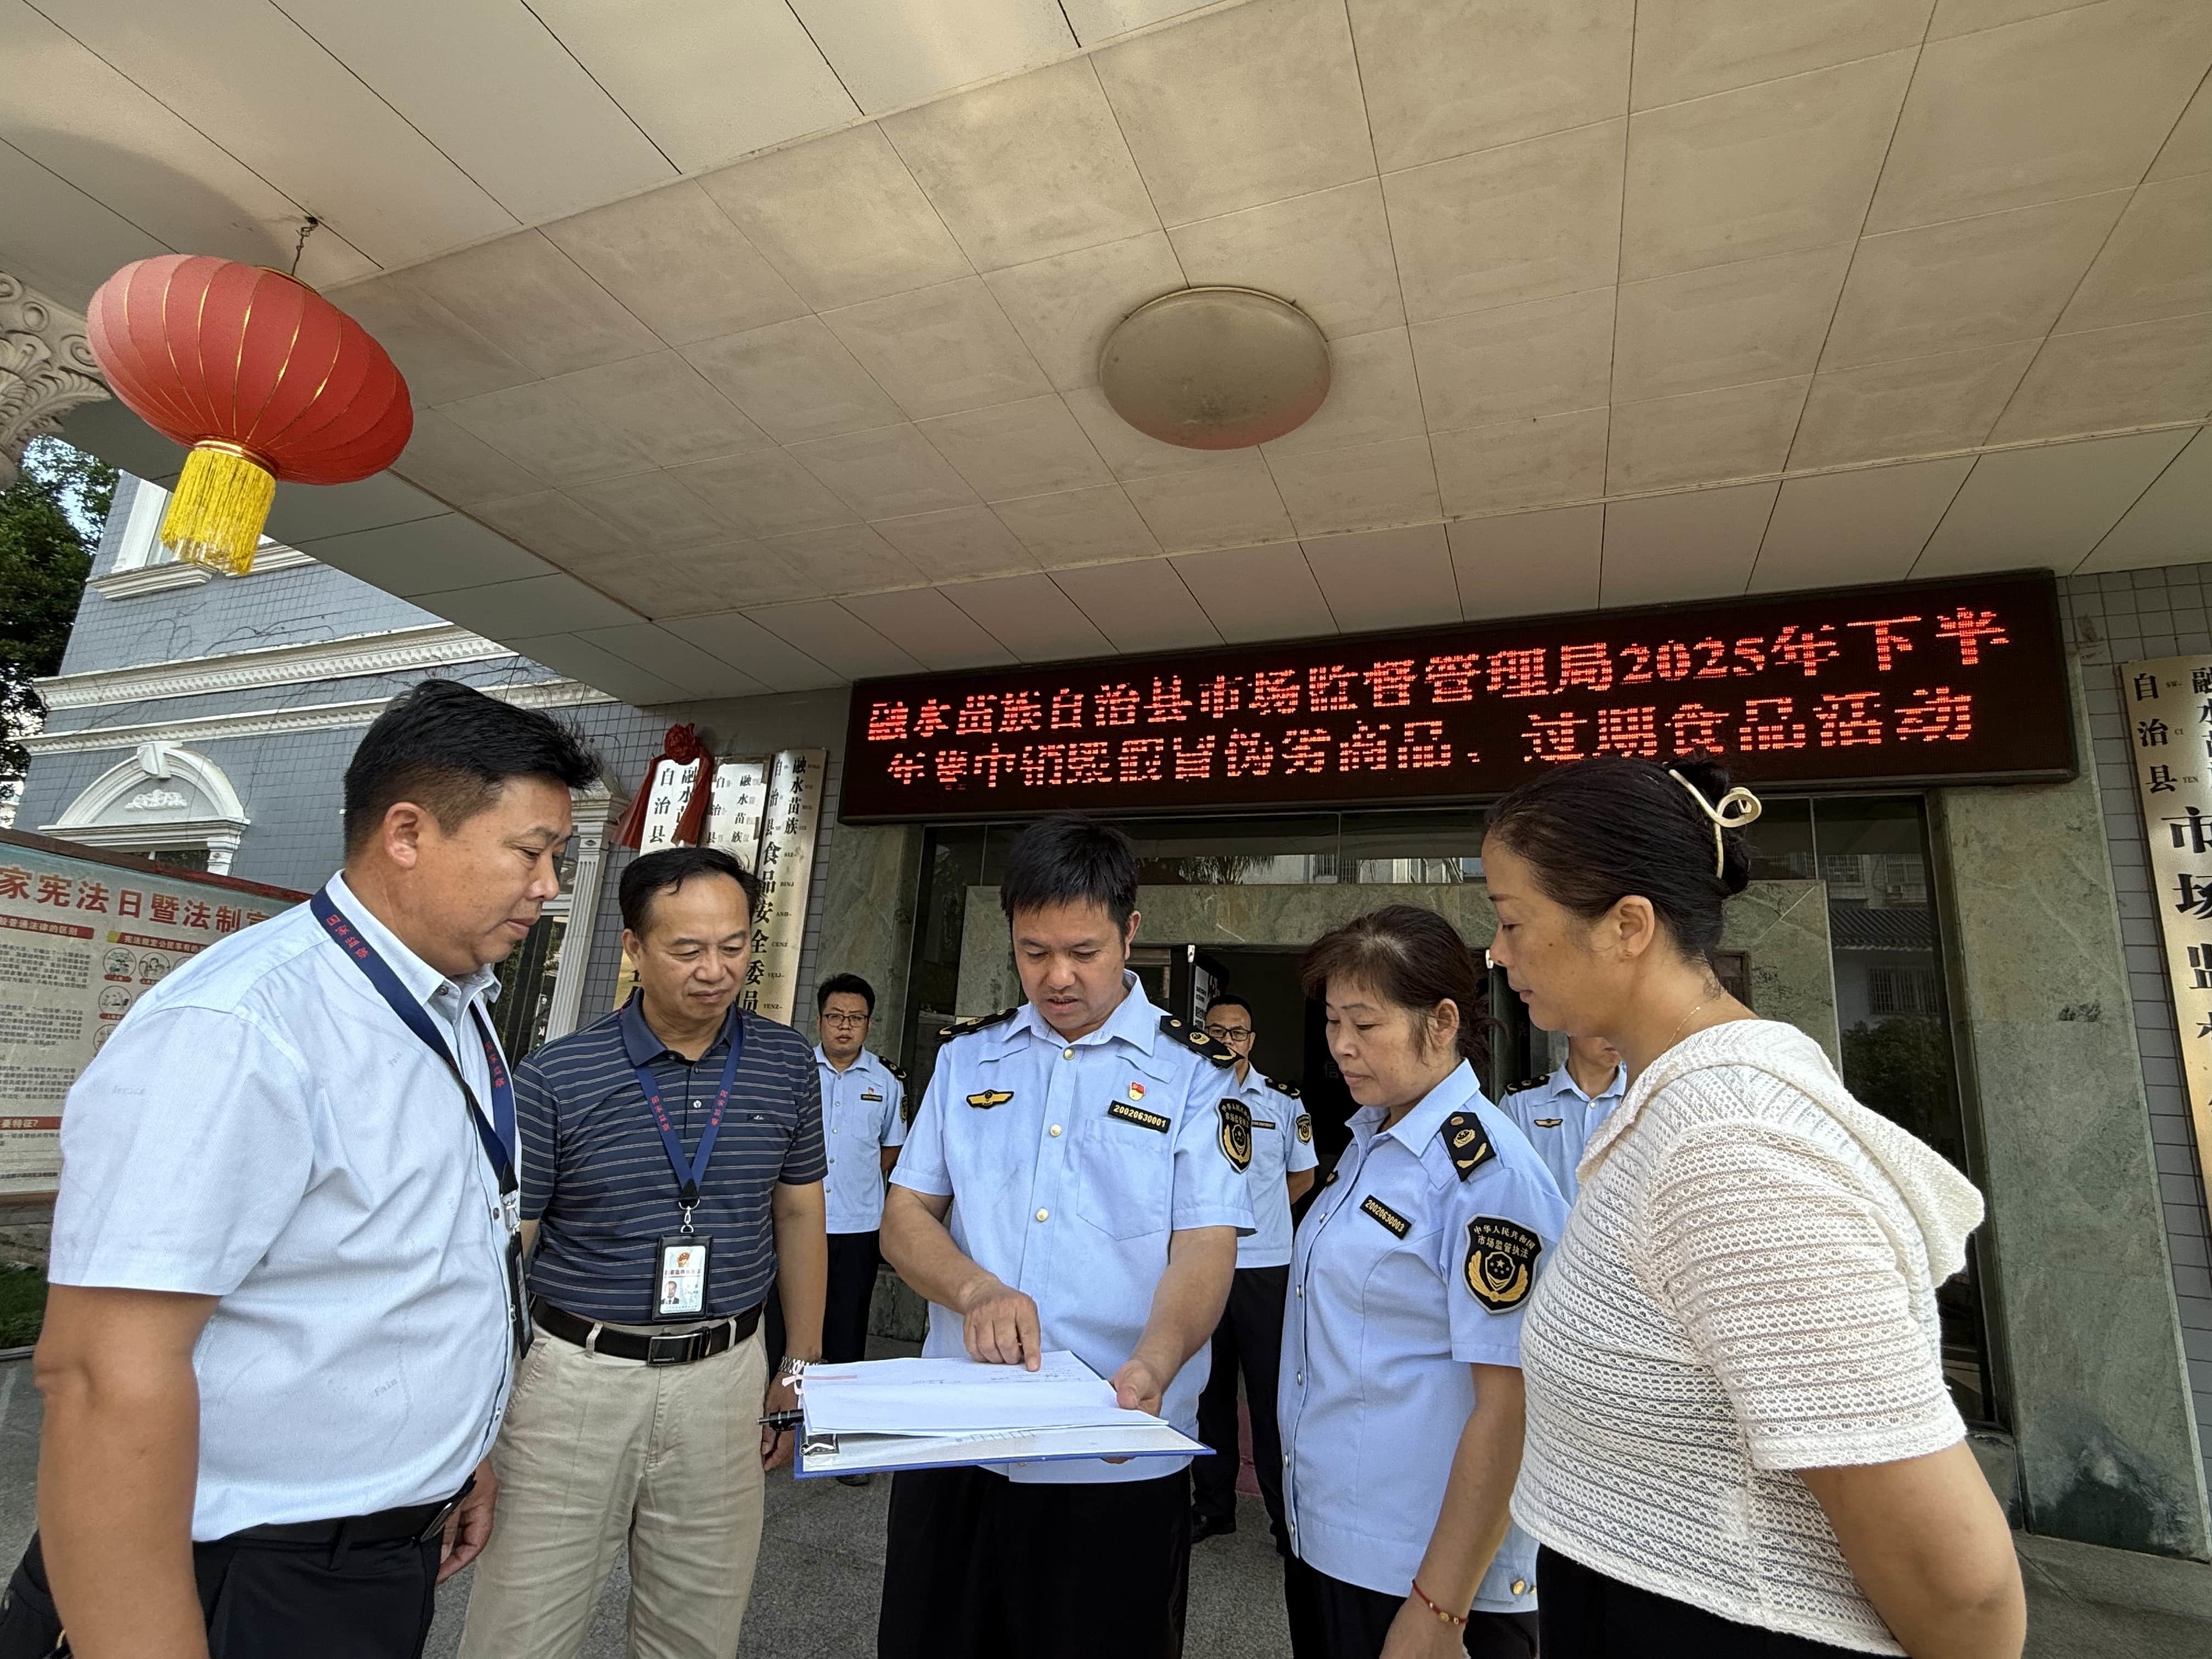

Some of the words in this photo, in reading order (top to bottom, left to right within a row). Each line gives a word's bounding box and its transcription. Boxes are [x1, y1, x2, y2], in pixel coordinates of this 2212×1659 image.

[867, 607, 2010, 740] 融水苗族自治县市场监督管理局2025年下半
[2134, 673, 2177, 794] 自治县
[649, 768, 675, 843] 自治县
[731, 774, 752, 843] 融水苗族
[765, 759, 783, 837] 自治县
[784, 755, 807, 835] 融水苗族
[1113, 1104, 1167, 1128] 20020630001
[1364, 1199, 1405, 1232] 20020630003
[1474, 1224, 1536, 1250] 中华人民共和国
[1477, 1234, 1529, 1259] 市场监管执法
